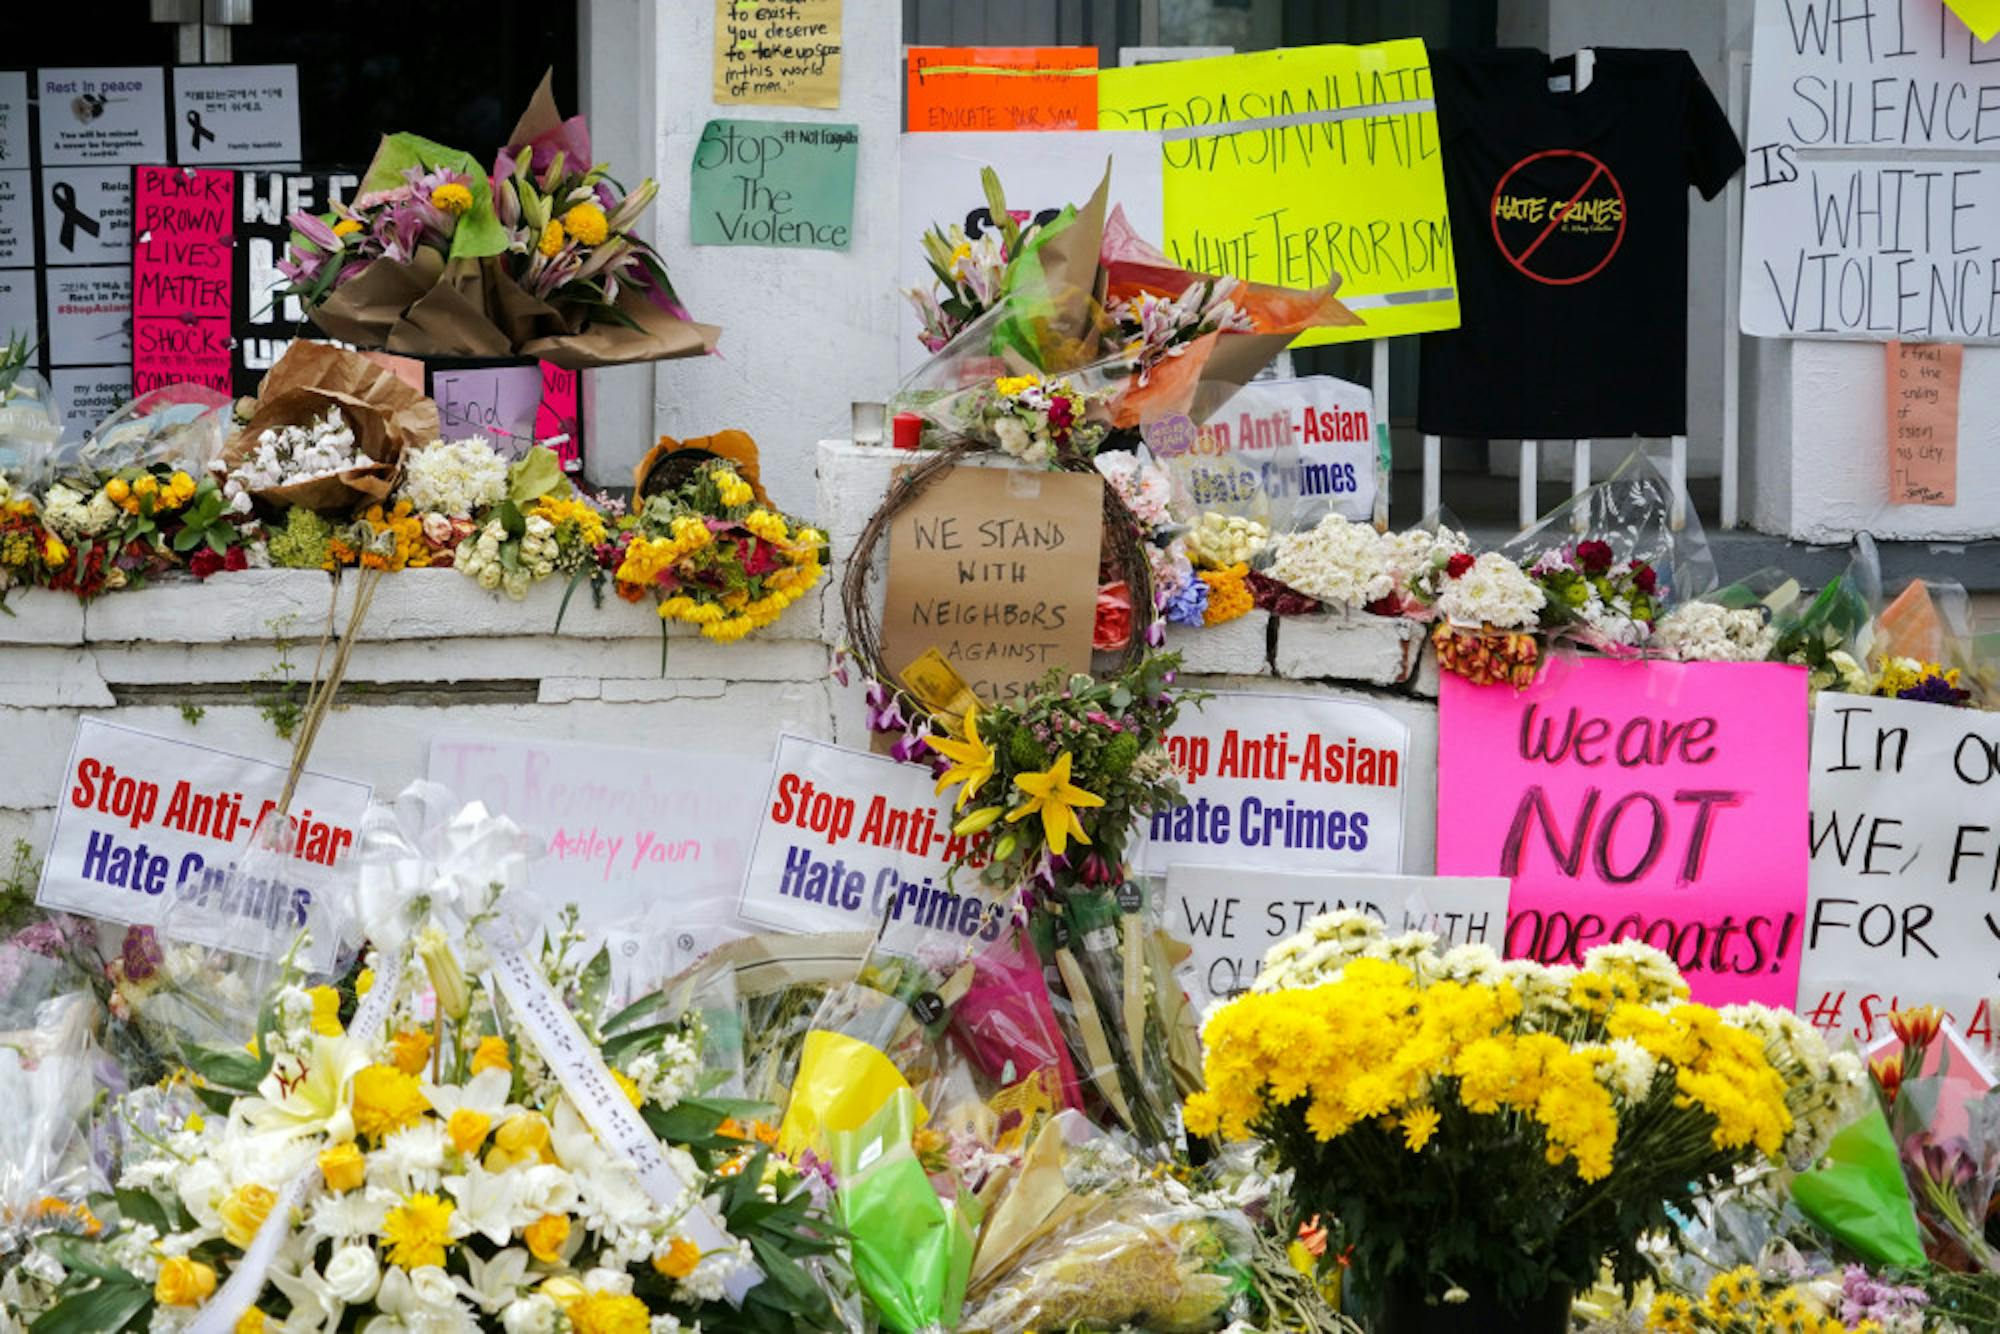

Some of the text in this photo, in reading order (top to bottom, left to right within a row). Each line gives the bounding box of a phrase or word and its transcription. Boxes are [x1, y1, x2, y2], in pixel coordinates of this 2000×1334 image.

[724, 45, 746, 62] to
[727, 21, 828, 49] you deserve
[47, 81, 77, 93] Rest
[100, 80, 142, 94] peace
[1787, 75, 2000, 145] SILENCE
[698, 122, 785, 179] Stop
[1750, 142, 1799, 189] IS
[101, 182, 130, 191] Rela
[146, 171, 222, 204] BLACK
[242, 172, 314, 226] WE
[733, 174, 793, 215] The
[99, 206, 130, 219] peac
[145, 206, 225, 236] BROWN
[716, 212, 848, 247] Violence
[1495, 195, 1624, 225] HATE CRIMES
[1811, 169, 1982, 255] WHITE
[146, 242, 221, 268] LIVES
[1255, 208, 1451, 289] TERRORISM
[57, 303, 132, 315] #StopAsian
[138, 271, 231, 309] MATTER
[1763, 248, 2000, 338] VIOLENCE
[139, 324, 221, 354] SHOCK
[96, 382, 132, 393] deepe
[445, 377, 503, 427] End
[1238, 403, 1370, 451] Anti-Asian
[1261, 457, 1358, 501] Crimes
[913, 517, 1066, 551] WE STAND
[957, 560, 1026, 585] WITH
[912, 598, 1068, 631] NEIGHBORS
[946, 640, 1060, 664] AGAINST
[1518, 703, 1719, 769] We are
[1825, 707, 1910, 773] In
[1217, 729, 1400, 788] Anti-Asian
[71, 756, 160, 830] Stop
[771, 773, 996, 870] Stop Anti-As
[1239, 795, 1370, 852] Crimes
[1499, 784, 1754, 889] NOT
[81, 829, 169, 896] Hate
[547, 826, 624, 881] Ashley
[779, 846, 1005, 943] Hate Crimes
[1182, 896, 1240, 939] WE
[1808, 898, 1939, 959] FOR
